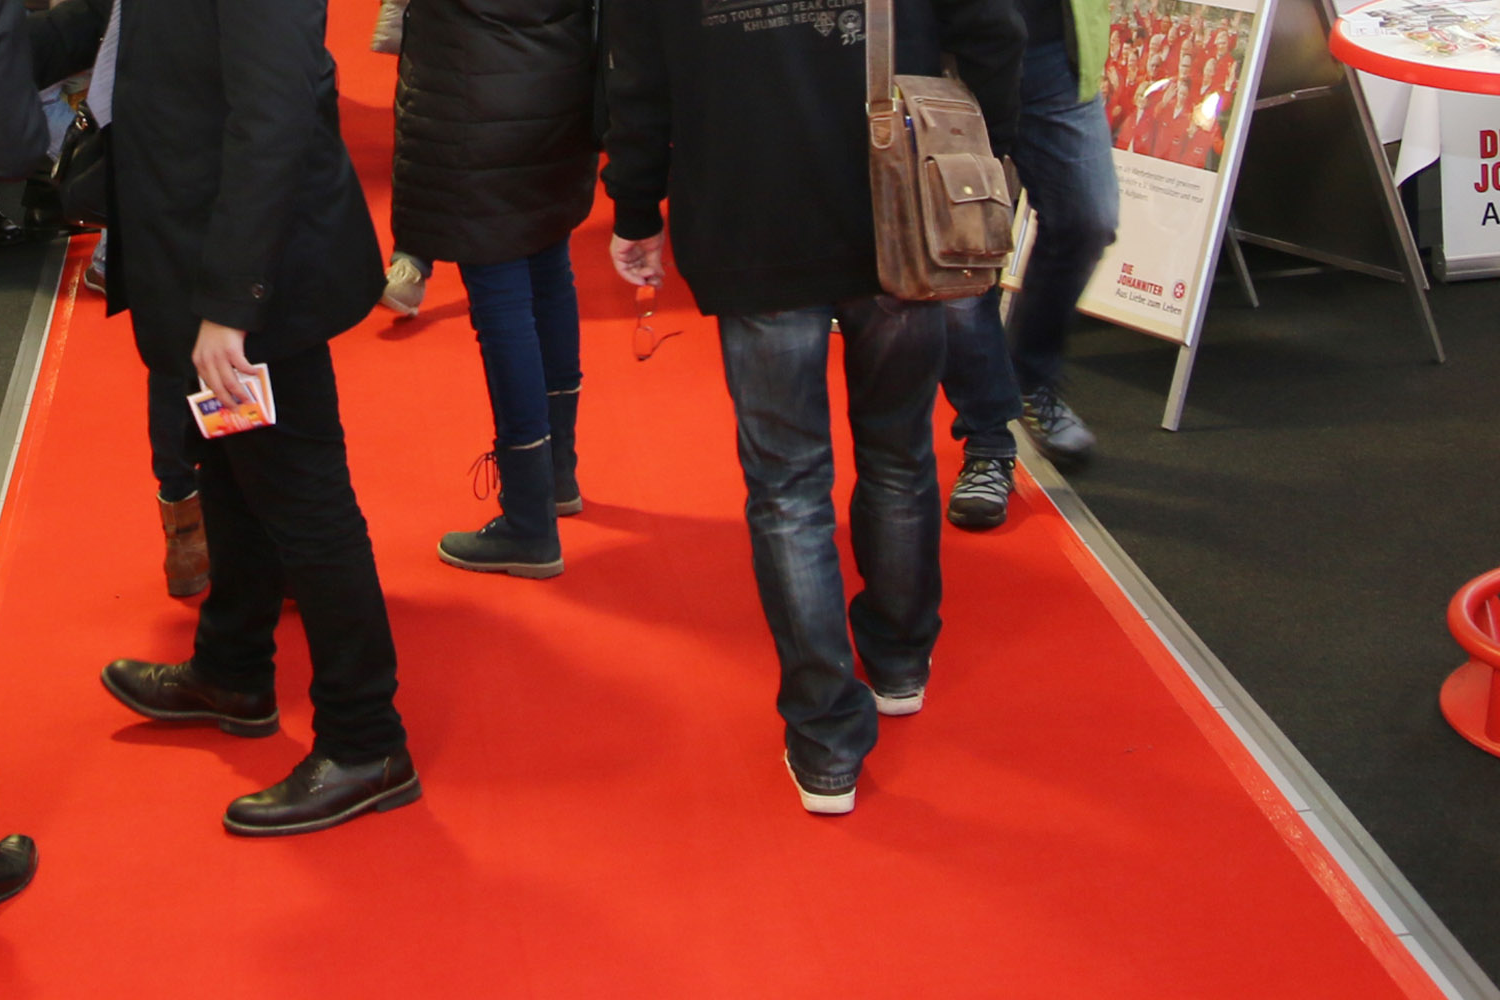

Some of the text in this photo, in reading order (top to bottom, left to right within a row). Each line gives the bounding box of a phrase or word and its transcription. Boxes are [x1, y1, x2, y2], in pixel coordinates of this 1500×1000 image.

[729, 8, 763, 22] TOUR
[766, 3, 789, 17] AND
[792, 0, 823, 12] PEAK
[1121, 262, 1134, 276] DIE
[1117, 274, 1164, 297] JOHANNITER
[1115, 288, 1182, 316] Aus Liebe zum Leben
